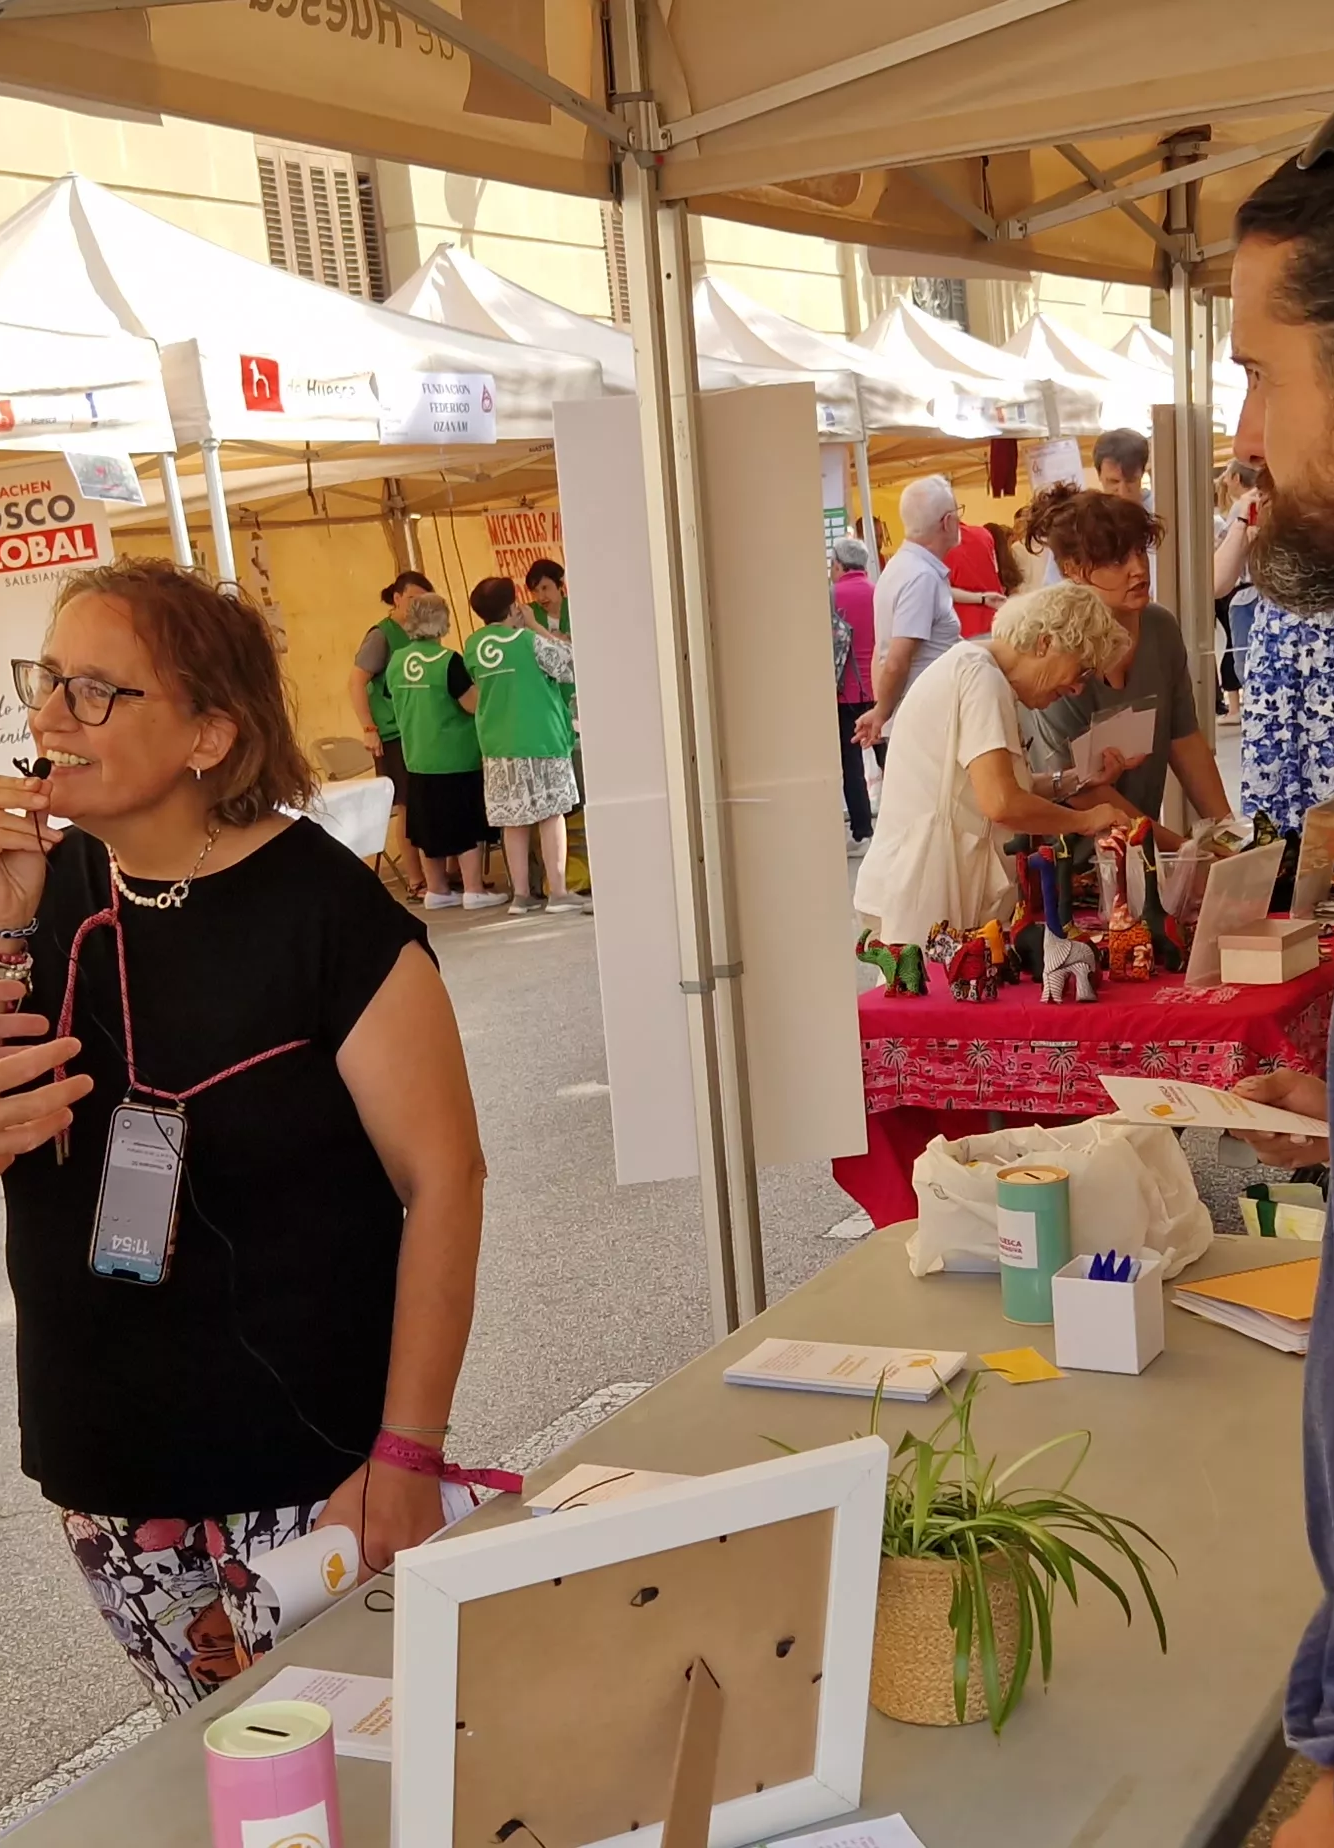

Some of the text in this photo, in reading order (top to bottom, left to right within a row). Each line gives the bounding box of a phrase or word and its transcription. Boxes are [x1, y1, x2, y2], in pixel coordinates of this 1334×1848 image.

[421, 379, 471, 397] FUNDACIÓN
[429, 401, 470, 414] FEDERICO
[433, 420, 468, 434] OZANAM
[486, 511, 548, 547] MIENTRAS
[111, 1234, 150, 1255] 11:54
